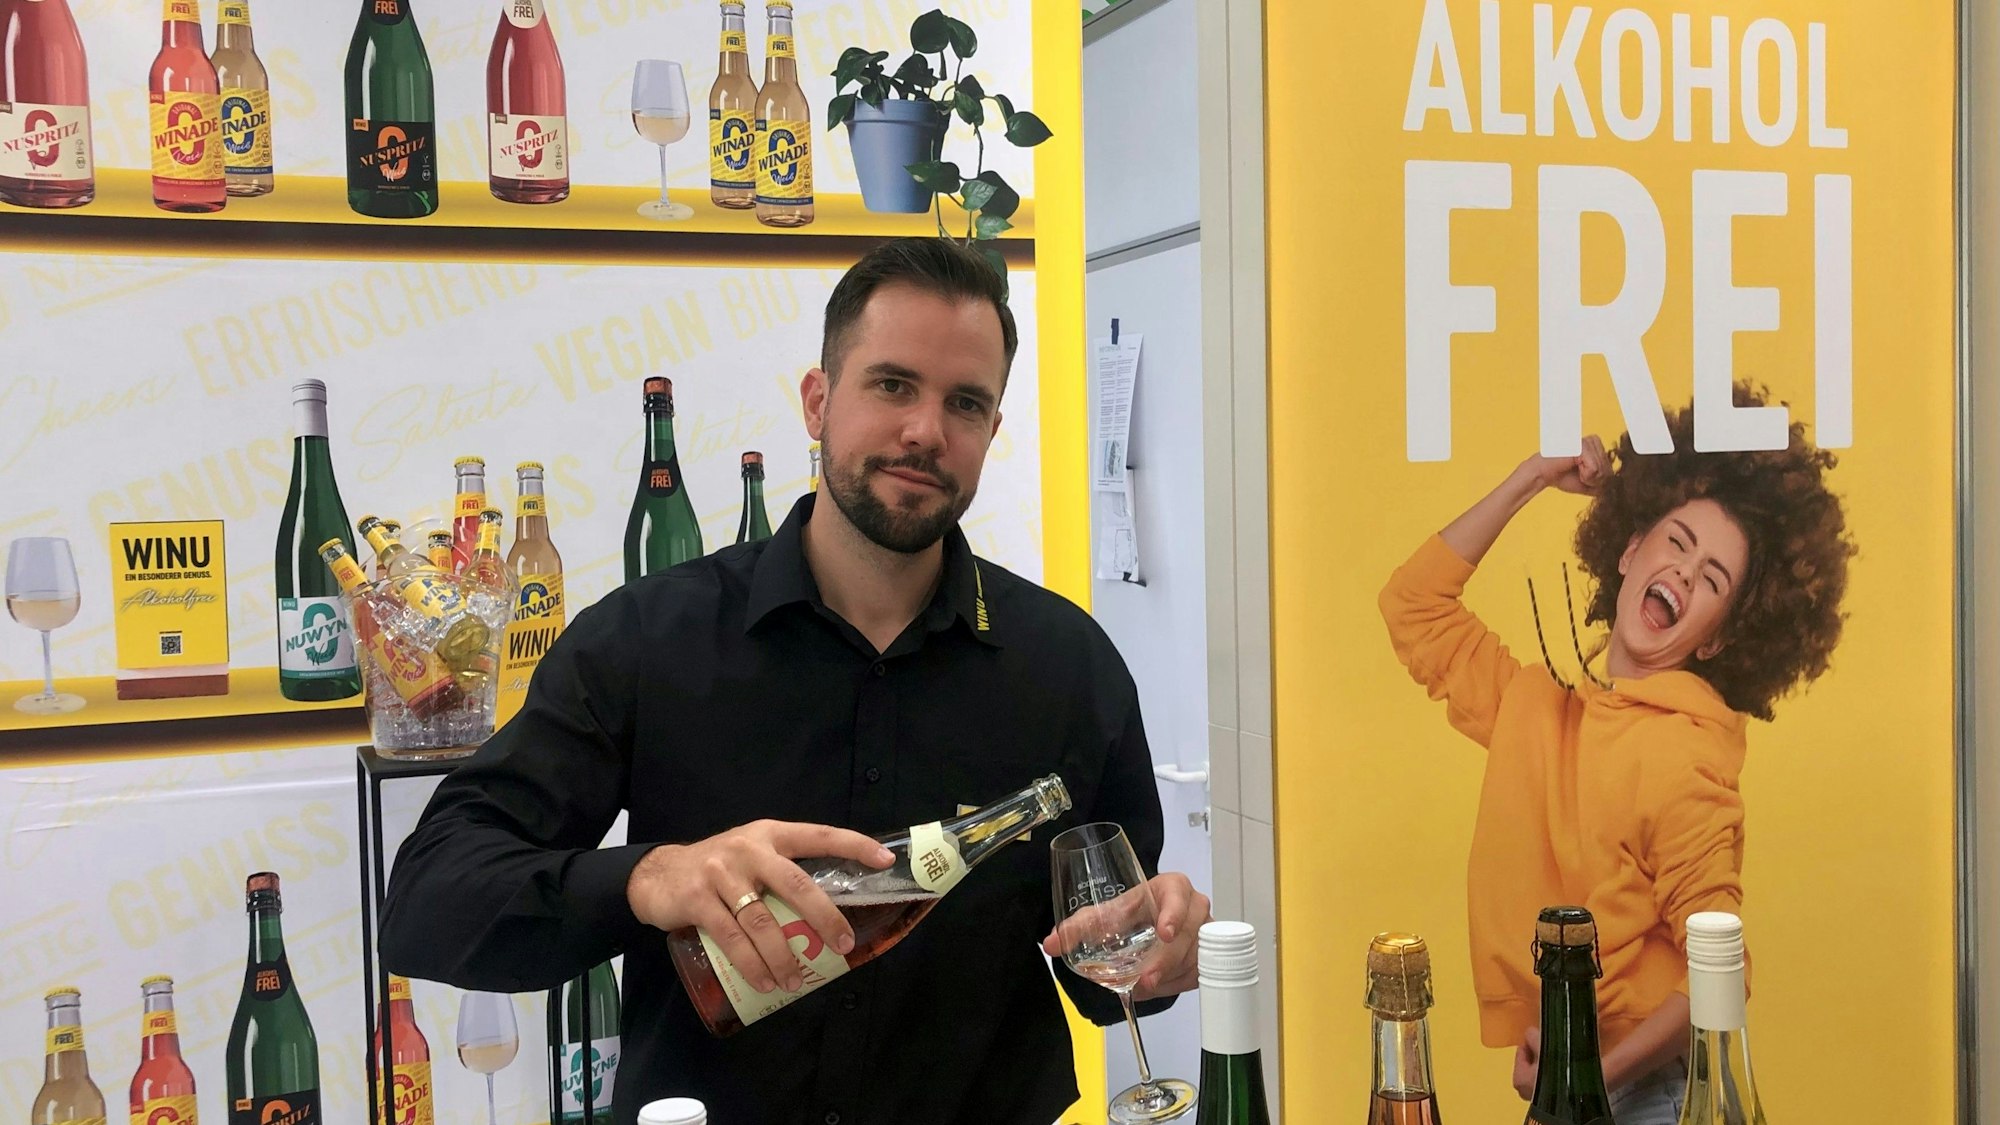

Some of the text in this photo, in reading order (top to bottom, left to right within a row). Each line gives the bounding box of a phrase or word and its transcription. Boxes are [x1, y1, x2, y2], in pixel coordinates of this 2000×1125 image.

[374, 0, 398, 15] FREI
[513, 6, 535, 19] FREI
[1402, 0, 1848, 148] ALKOHOL
[4, 121, 79, 154] NUSPRITZ
[155, 117, 218, 149] WINADE
[222, 110, 267, 137] INADE
[360, 136, 425, 168] NUSPRITZ
[500, 129, 559, 159] NUSPRITZ
[713, 133, 755, 157] WINAD
[758, 142, 808, 171] WINADE
[1404, 159, 1853, 462] FREI
[532, 289, 715, 404] VEGAN
[650, 475, 672, 488] FREI
[462, 501, 479, 510] FREI
[122, 536, 210, 570] WINU
[138, 572, 182, 581] BESONDERER
[183, 571, 212, 579] GENUSS.
[976, 597, 990, 631] WINU
[286, 617, 347, 652] NUWYN
[920, 851, 944, 883] FREI
[932, 847, 951, 874] ALKOHOL
[256, 975, 281, 992] FREI
